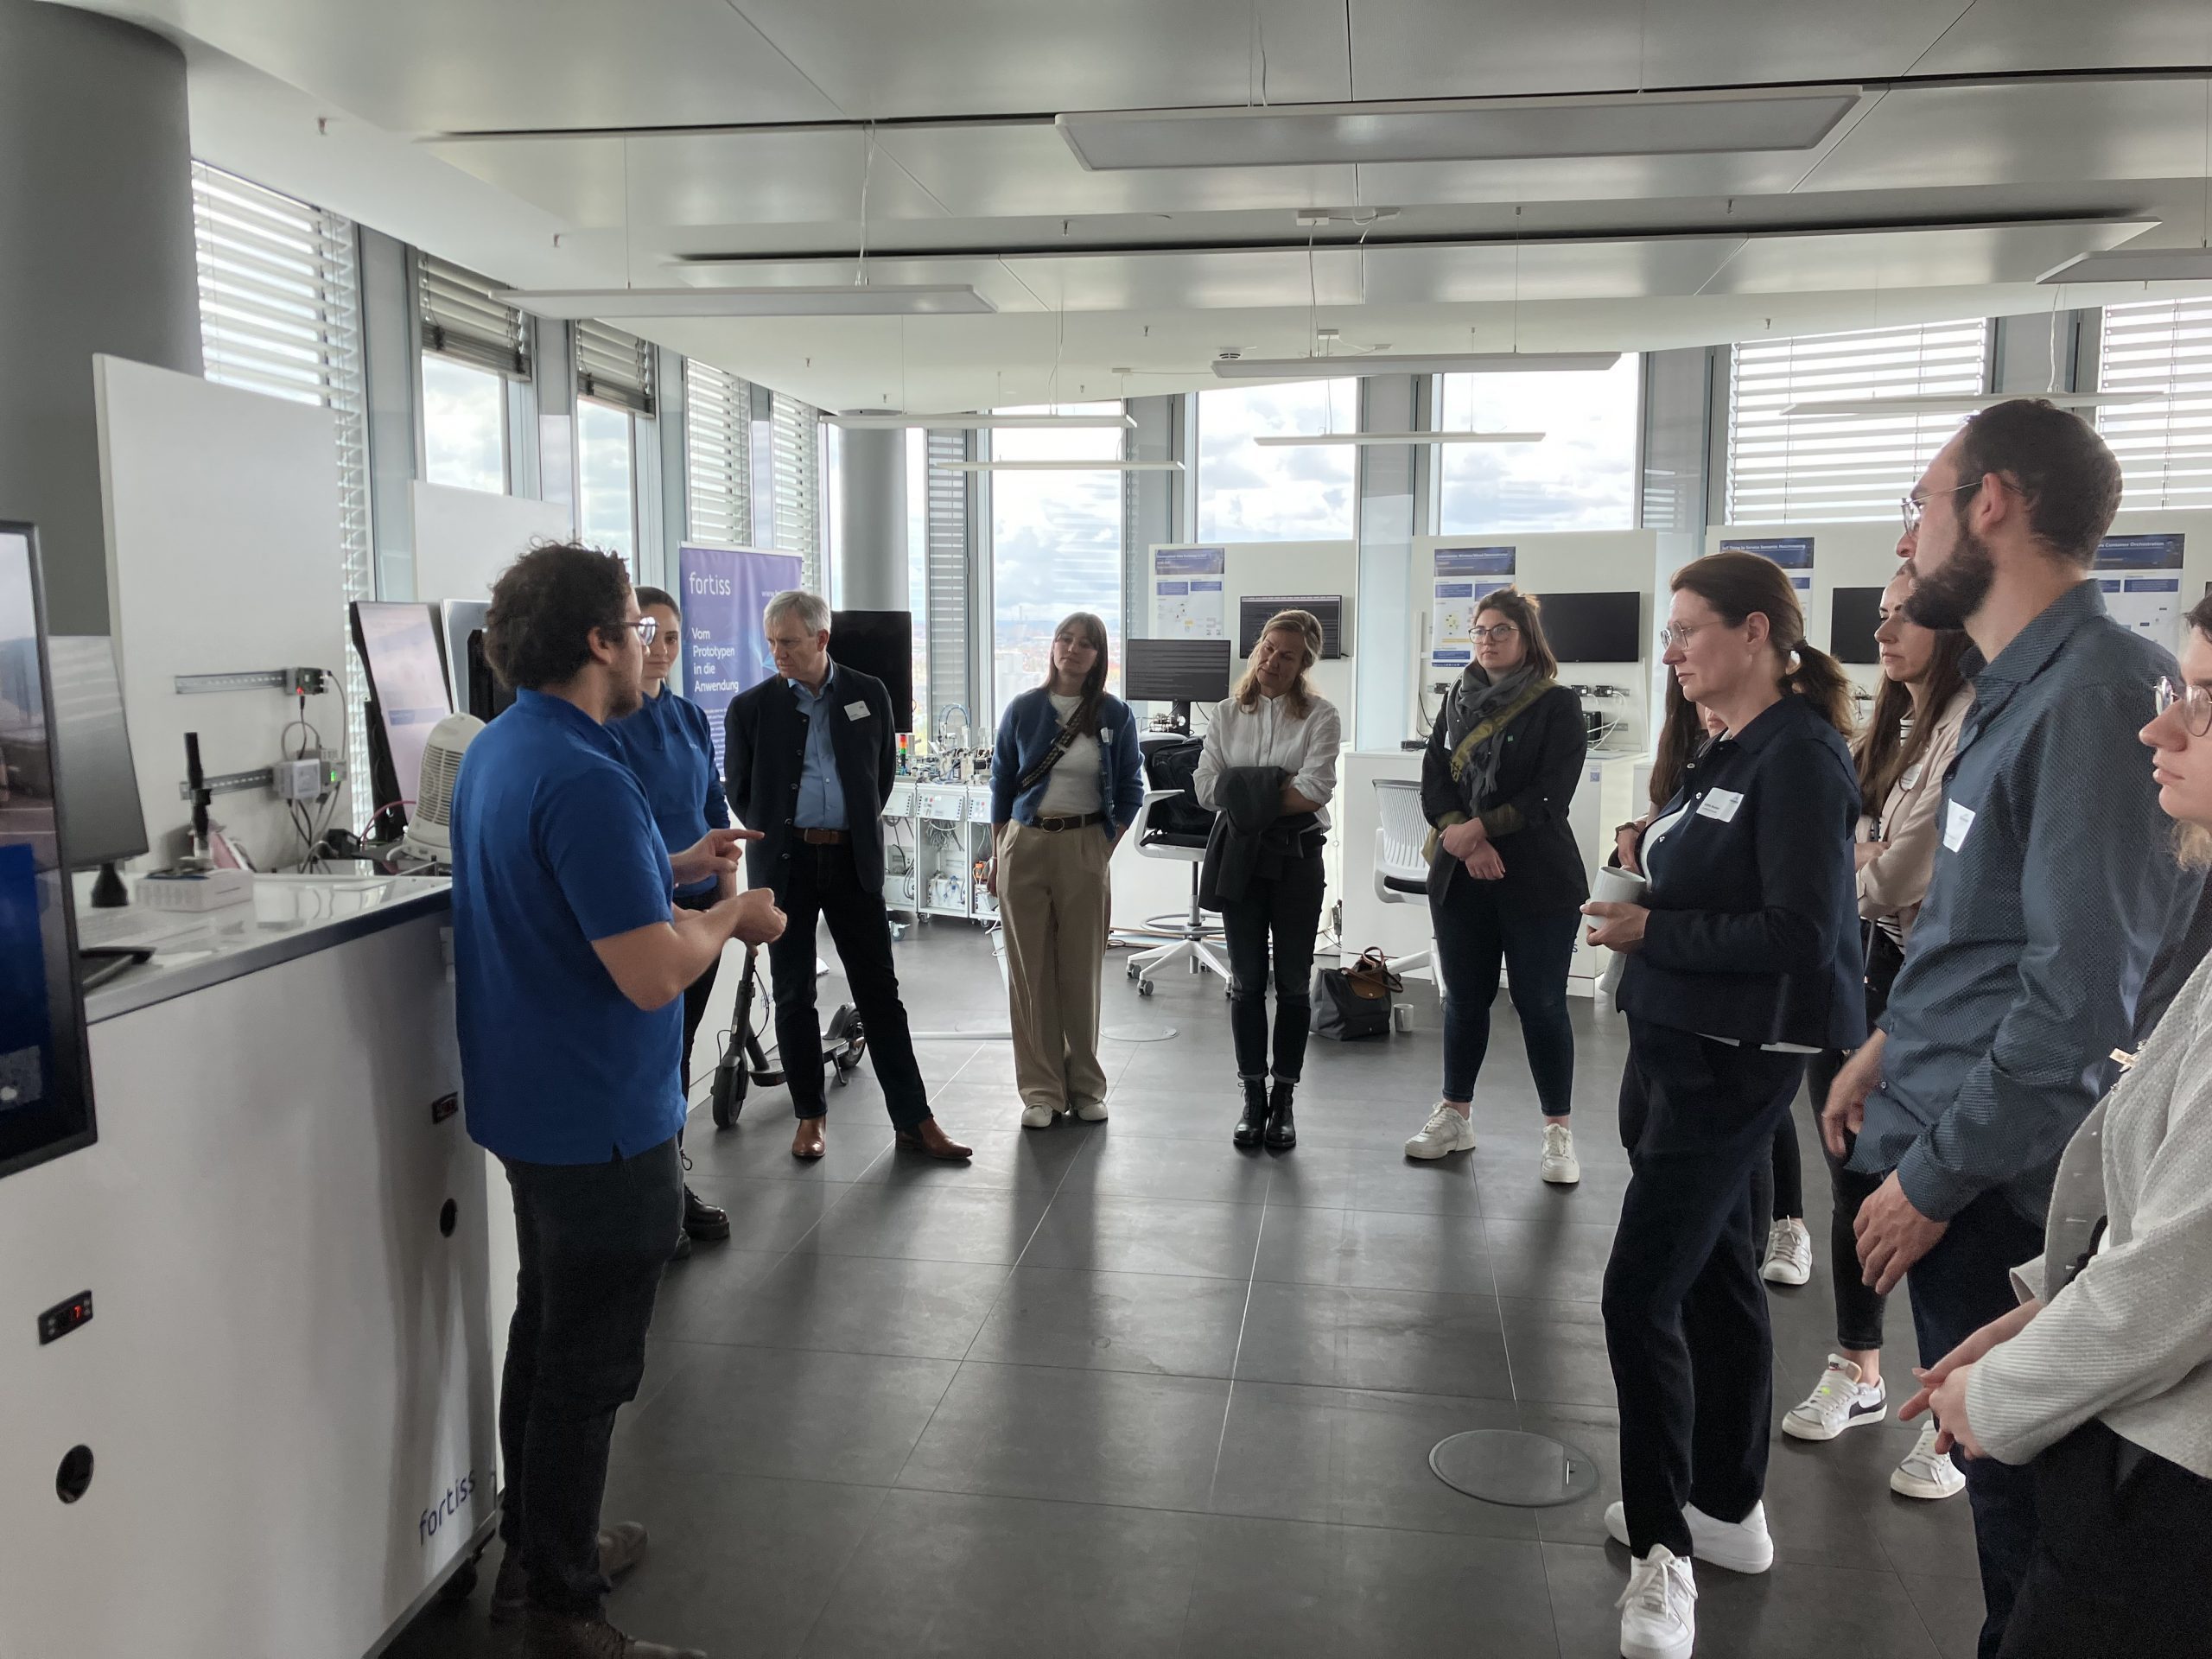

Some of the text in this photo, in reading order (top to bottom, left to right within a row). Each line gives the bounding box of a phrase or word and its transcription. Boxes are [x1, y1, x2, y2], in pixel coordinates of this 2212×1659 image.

[689, 571, 731, 596] fortiss
[691, 627, 710, 640] Vom
[692, 645, 735, 659] Prototypen
[693, 663, 715, 675] in die
[694, 679, 740, 693] Anwendung
[419, 1470, 476, 1546] fortiss
